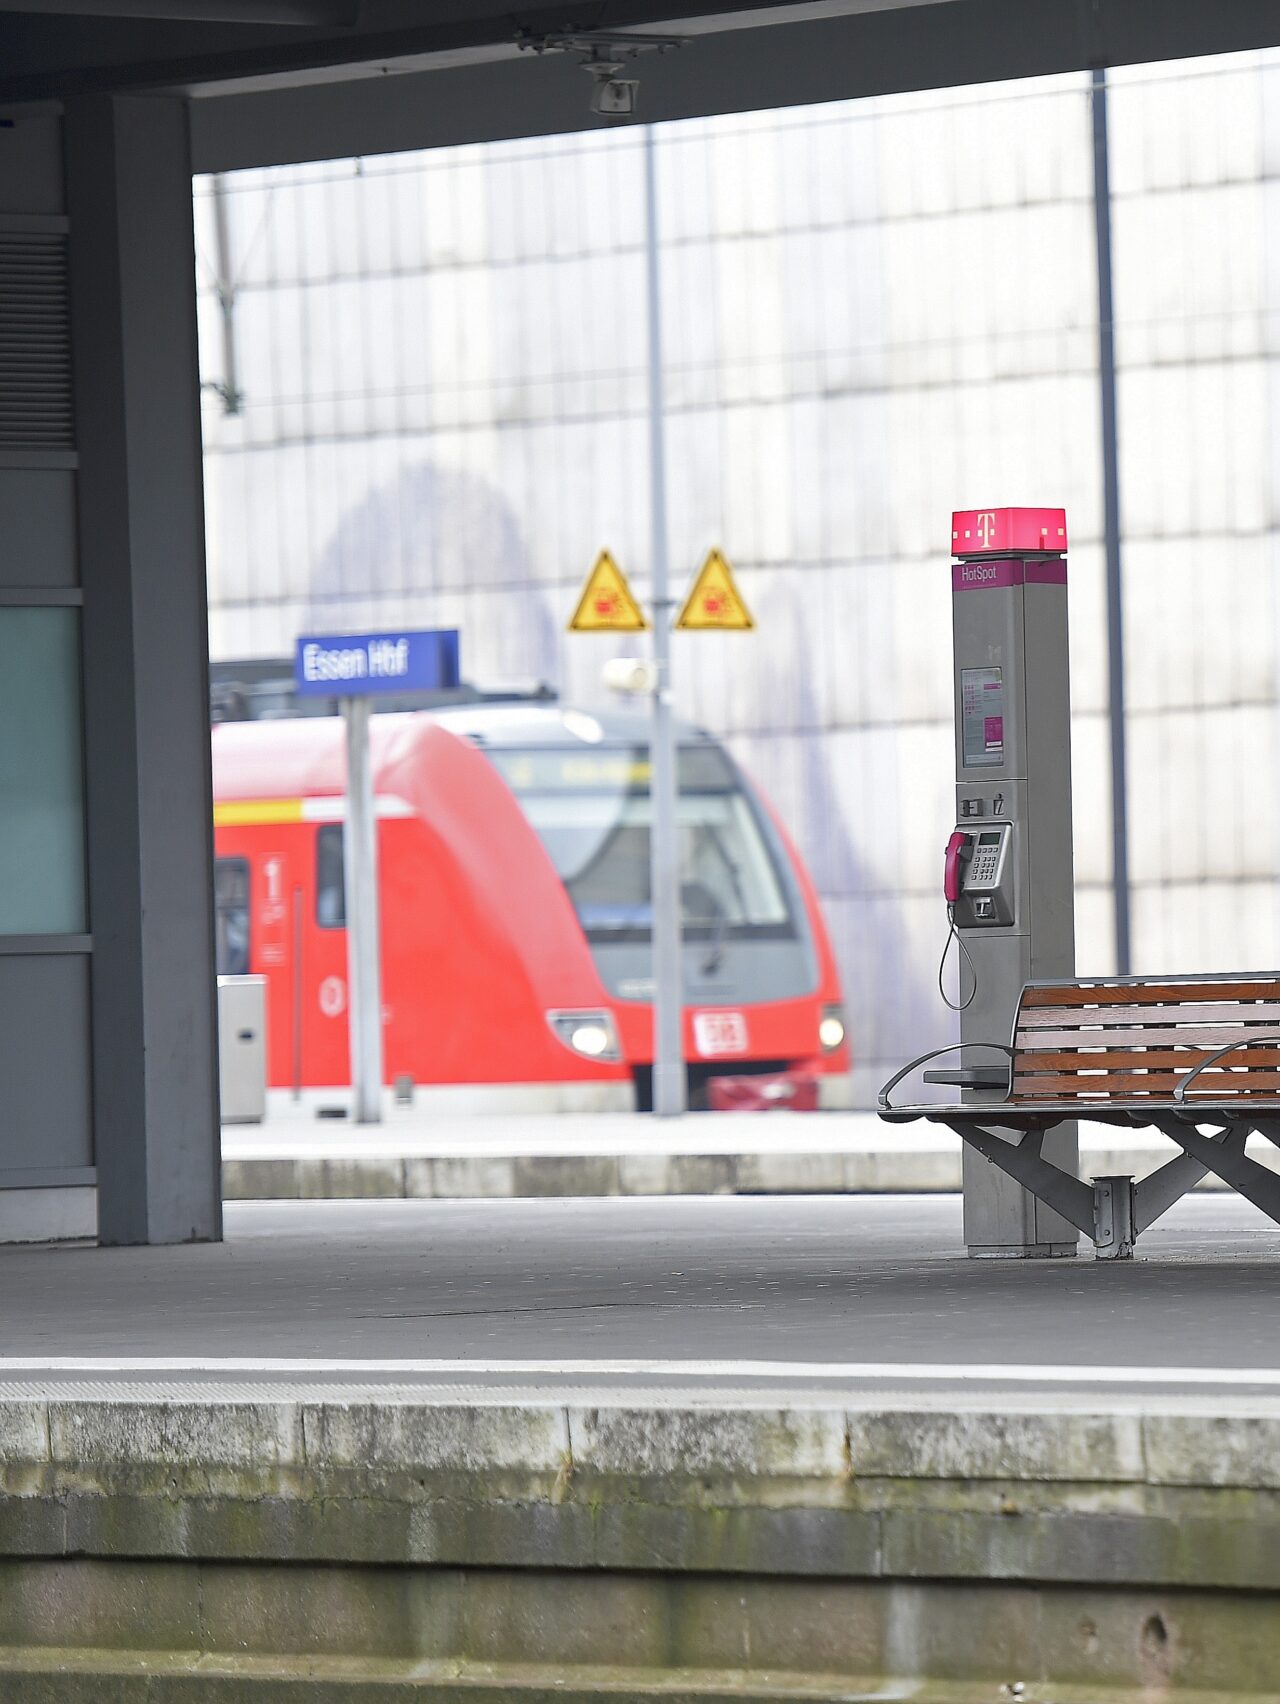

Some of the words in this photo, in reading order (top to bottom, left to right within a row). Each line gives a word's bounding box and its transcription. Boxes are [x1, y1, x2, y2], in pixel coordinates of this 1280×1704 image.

[977, 512, 995, 548] T
[961, 566, 997, 582] HotSpot
[303, 643, 367, 681] Essen
[368, 638, 409, 677] Hbf
